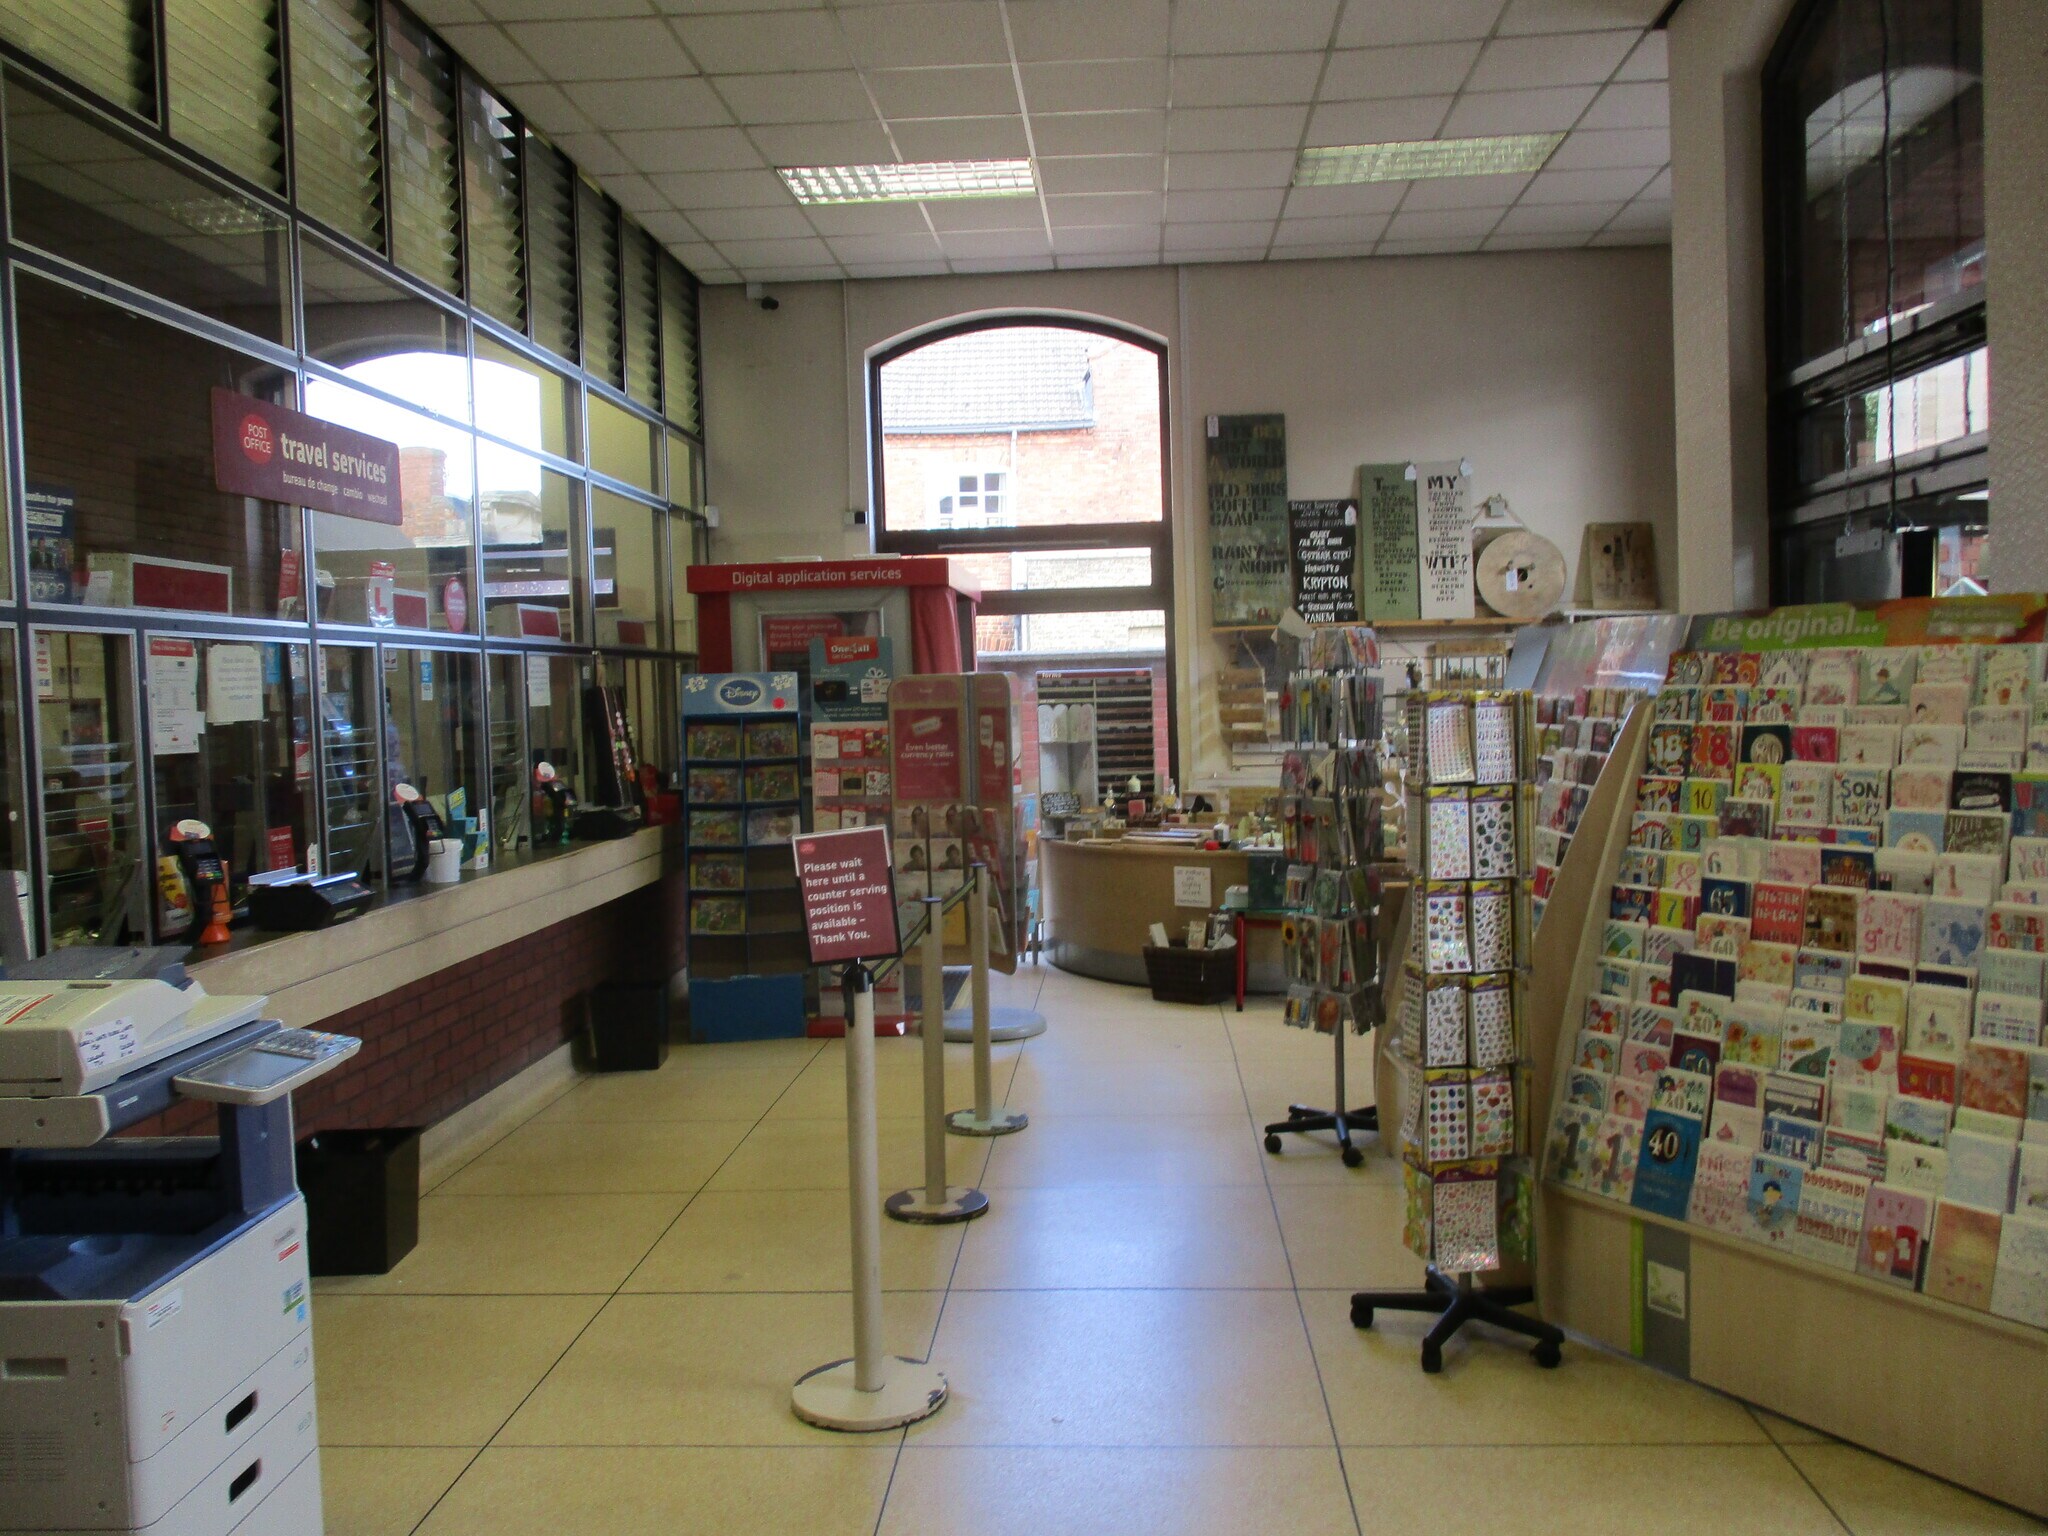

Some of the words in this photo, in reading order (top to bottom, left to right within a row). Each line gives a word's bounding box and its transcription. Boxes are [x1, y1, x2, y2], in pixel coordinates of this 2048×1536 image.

[247, 423, 268, 437] POST
[243, 438, 272, 454] OFFICE
[280, 432, 328, 469] travel
[332, 453, 387, 484] services
[282, 471, 306, 487] bureau
[307, 478, 316, 490] de
[317, 479, 338, 496] change
[343, 486, 363, 499] cambio
[1428, 475, 1457, 489] MY
[732, 571, 773, 586] Digital
[777, 569, 846, 585] application
[850, 568, 902, 581] services
[1303, 575, 1349, 591] KRYPTON
[1304, 612, 1335, 623] PANEM
[1711, 617, 1744, 641] Be
[1747, 606, 1880, 645] original...
[1719, 656, 1758, 687] 30
[722, 687, 758, 699] Disney
[905, 743, 924, 751] Even
[925, 743, 948, 751] better
[1653, 735, 1683, 769] 18
[1695, 726, 1730, 766] 18
[900, 750, 934, 760] currency
[1841, 779, 1879, 799] SON
[1693, 788, 1712, 810] 10
[1842, 801, 1880, 816] happy
[1687, 822, 1701, 849] 9
[804, 862, 837, 873] Please
[839, 857, 863, 869] wait
[805, 877, 829, 887] here
[832, 872, 856, 884] until
[807, 889, 847, 902] counter
[849, 883, 888, 896] serving
[1757, 889, 1800, 906] SISTER
[809, 903, 850, 918] position
[853, 901, 862, 911] is
[811, 917, 857, 931] available
[813, 932, 846, 945] Thank
[848, 930, 871, 941] You.
[1648, 1128, 1679, 1160] 40
